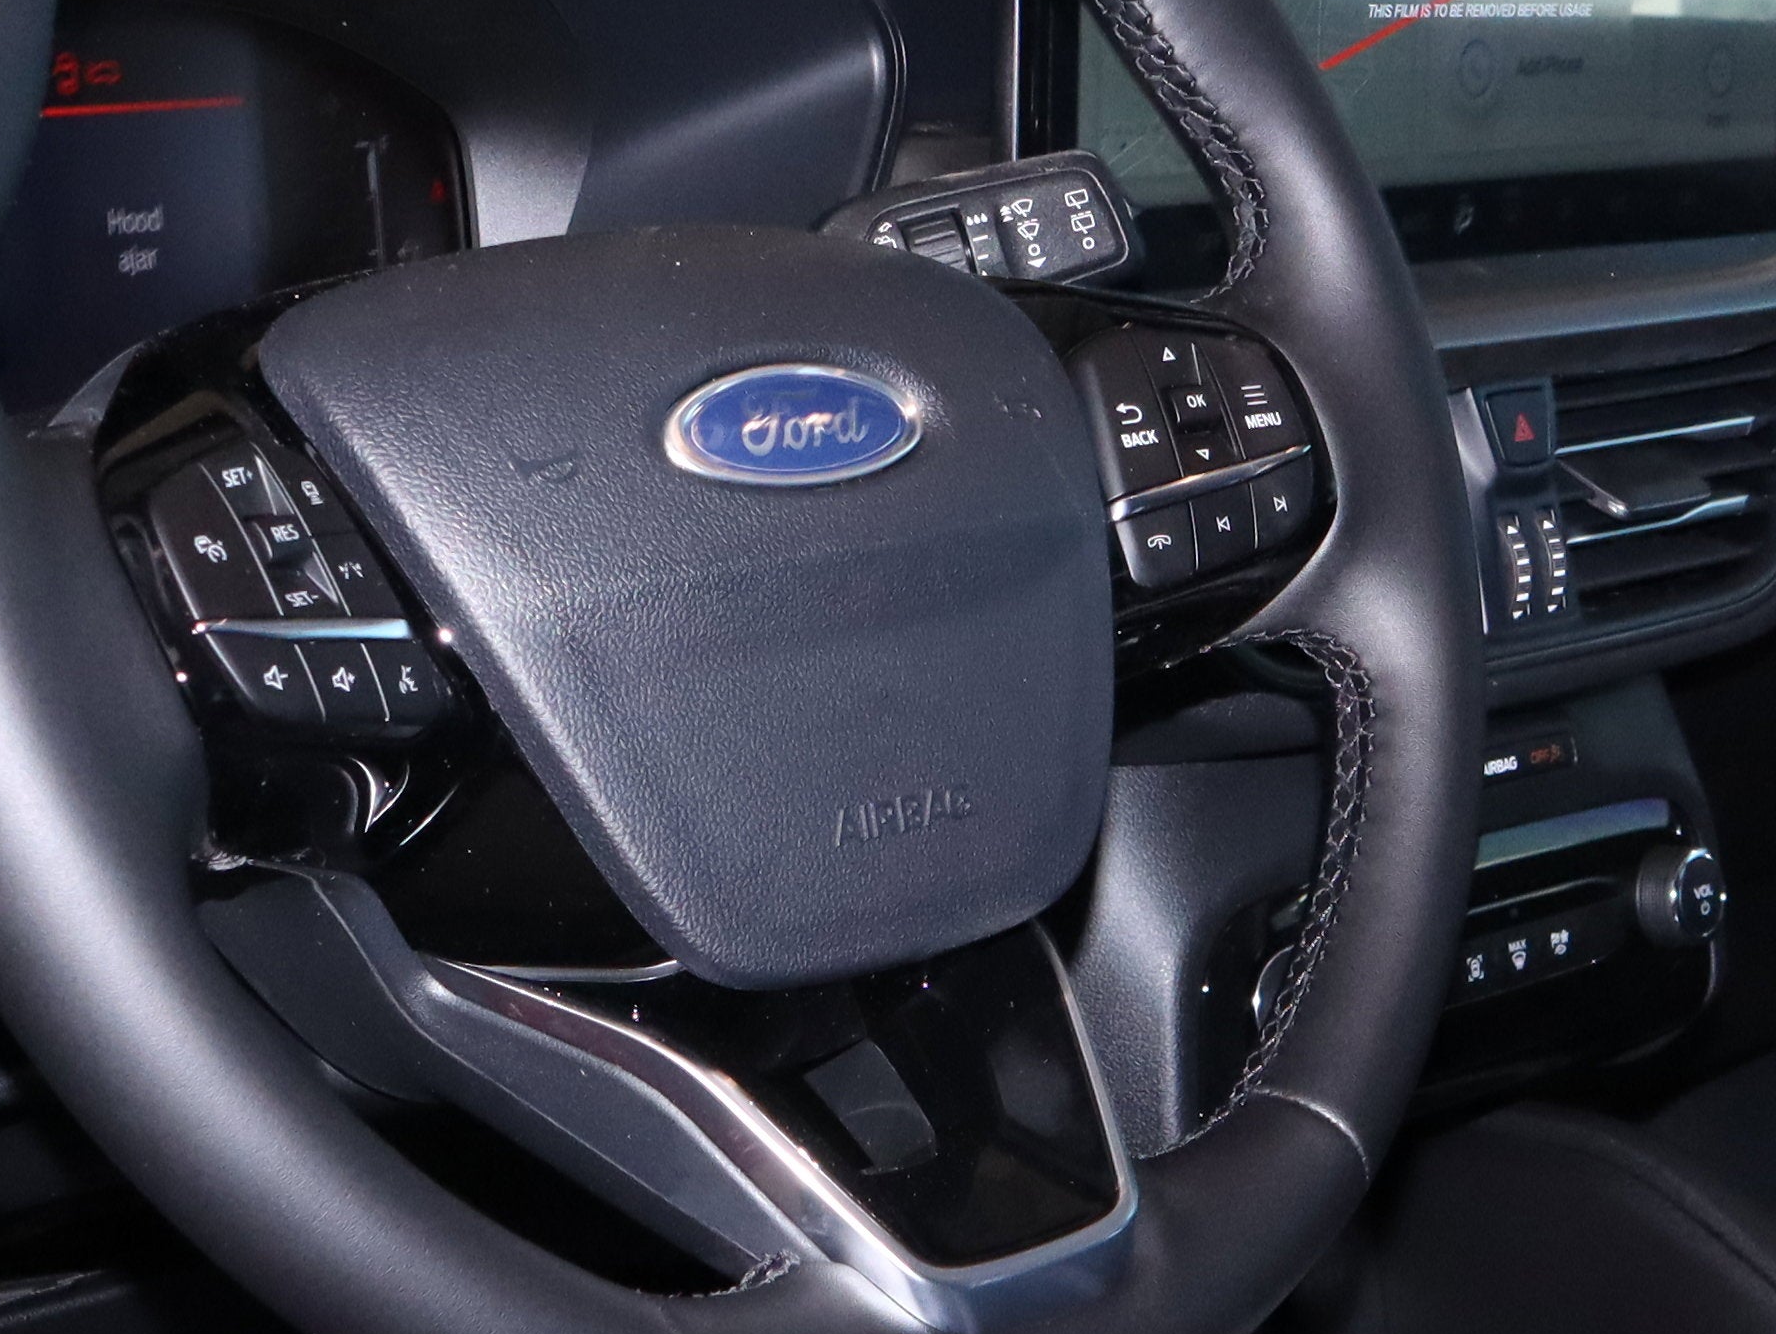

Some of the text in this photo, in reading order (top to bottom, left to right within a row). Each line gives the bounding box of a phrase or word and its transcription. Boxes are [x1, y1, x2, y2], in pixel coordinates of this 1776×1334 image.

[1368, 3, 1593, 19] THIS FILM IS TO BE REMOVED BEFORE USAGE
[107, 203, 163, 236] Hood
[118, 243, 159, 276] ajar
[1185, 393, 1207, 408] OK
[740, 396, 872, 457] Ford
[1244, 411, 1282, 430] MENU
[1120, 429, 1160, 448] BACK
[221, 465, 254, 489] SET+
[270, 523, 299, 543] RES
[835, 788, 972, 848] AIRBAG
[1693, 883, 1714, 900] VOL
[1508, 938, 1527, 954] MAX
